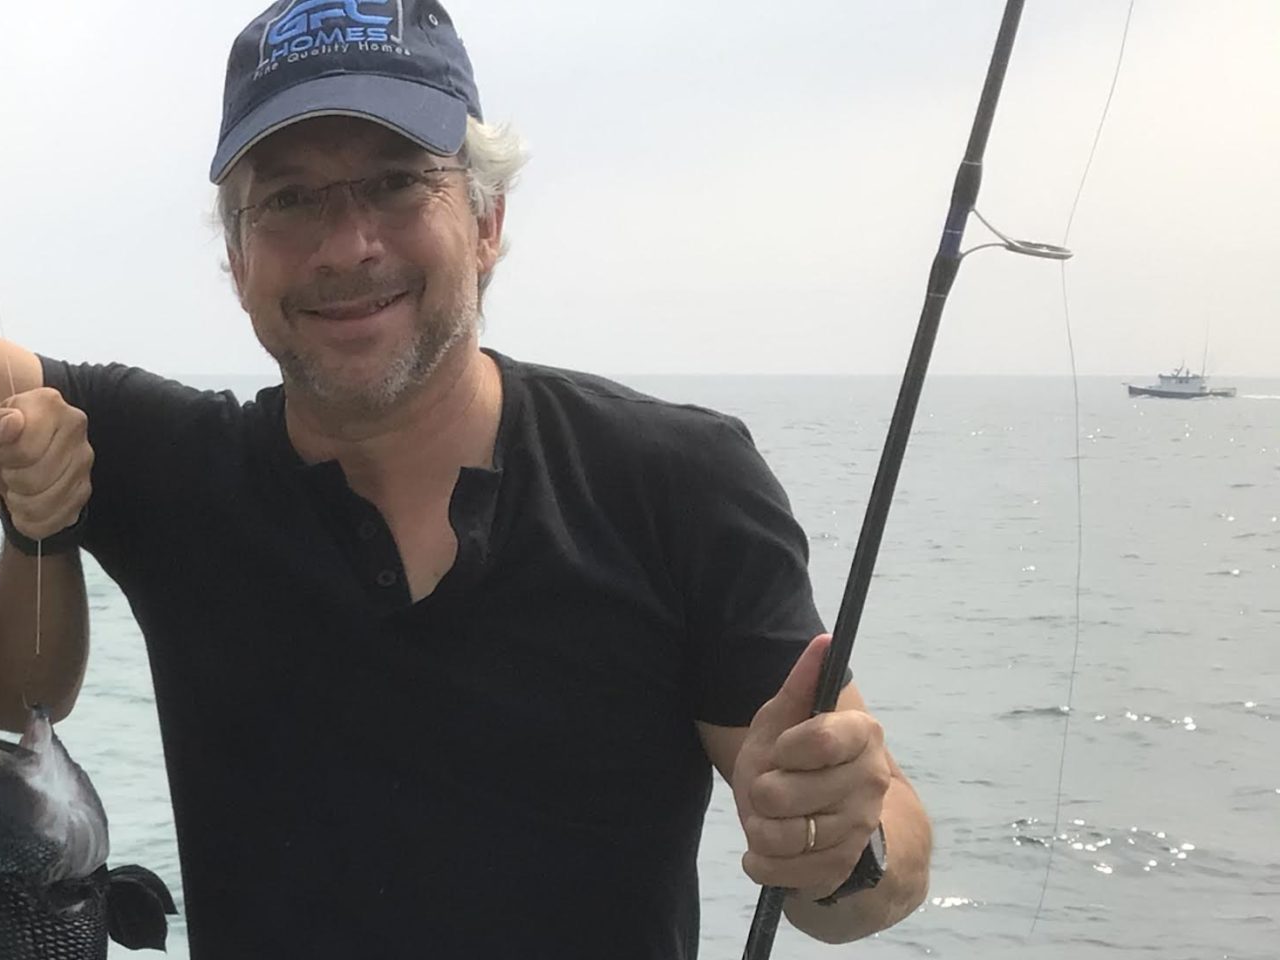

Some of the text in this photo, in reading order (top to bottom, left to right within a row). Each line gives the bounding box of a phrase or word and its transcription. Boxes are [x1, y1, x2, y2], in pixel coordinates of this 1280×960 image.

[271, 26, 388, 62] HOMES
[286, 41, 349, 63] Quality
[358, 42, 411, 56] Homes
